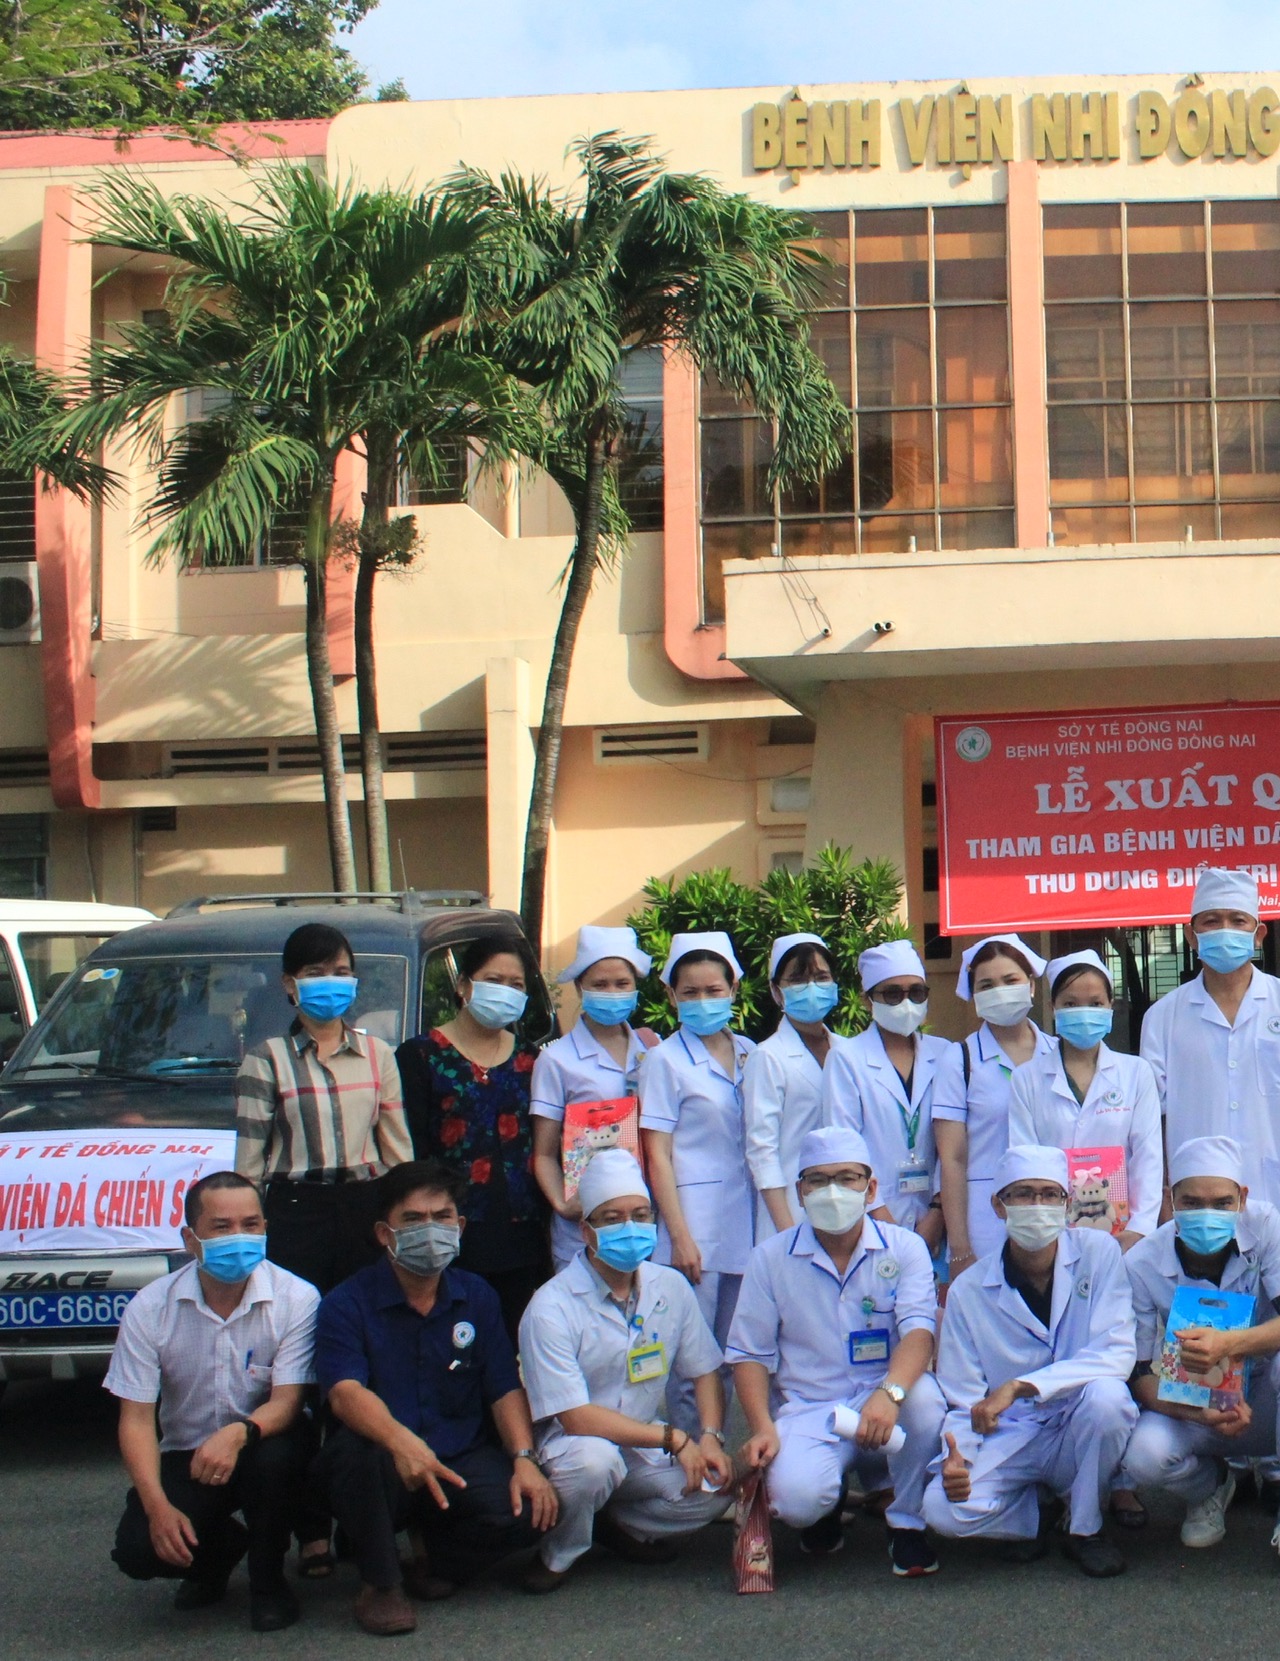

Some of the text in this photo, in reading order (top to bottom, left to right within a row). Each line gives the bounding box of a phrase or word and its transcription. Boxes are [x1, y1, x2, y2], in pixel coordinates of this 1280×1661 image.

[753, 86, 881, 185] BỆNH
[900, 80, 1014, 180] VIỆN
[1032, 91, 1120, 161] NHI
[1058, 722, 1082, 738] SỞ
[1085, 723, 1096, 736] Y
[1100, 720, 1120, 736] TẾ
[1176, 719, 1203, 732] NAI
[1006, 742, 1050, 760] BỆNH
[1053, 739, 1091, 758] VIỆN
[1095, 740, 1122, 754] NHI
[1229, 734, 1256, 748] NAI
[1034, 765, 1092, 815] LỄ
[1104, 762, 1239, 812] XUẤT
[965, 836, 1042, 860] THAM
[1050, 833, 1096, 856] GIA
[1104, 828, 1175, 856] BỆNH
[1184, 824, 1245, 852] VIỆN
[1024, 871, 1076, 894] THU
[1084, 870, 1158, 892] DUNG
[1258, 894, 1280, 907] Nai,
[15, 1146, 36, 1159] Y
[39, 1141, 79, 1158] TẾ
[76, 1139, 157, 1157] ĐỒNG
[160, 1144, 214, 1155] NAI
[0, 1173, 51, 1243] VIỆN
[94, 1165, 165, 1228] CHIẾN
